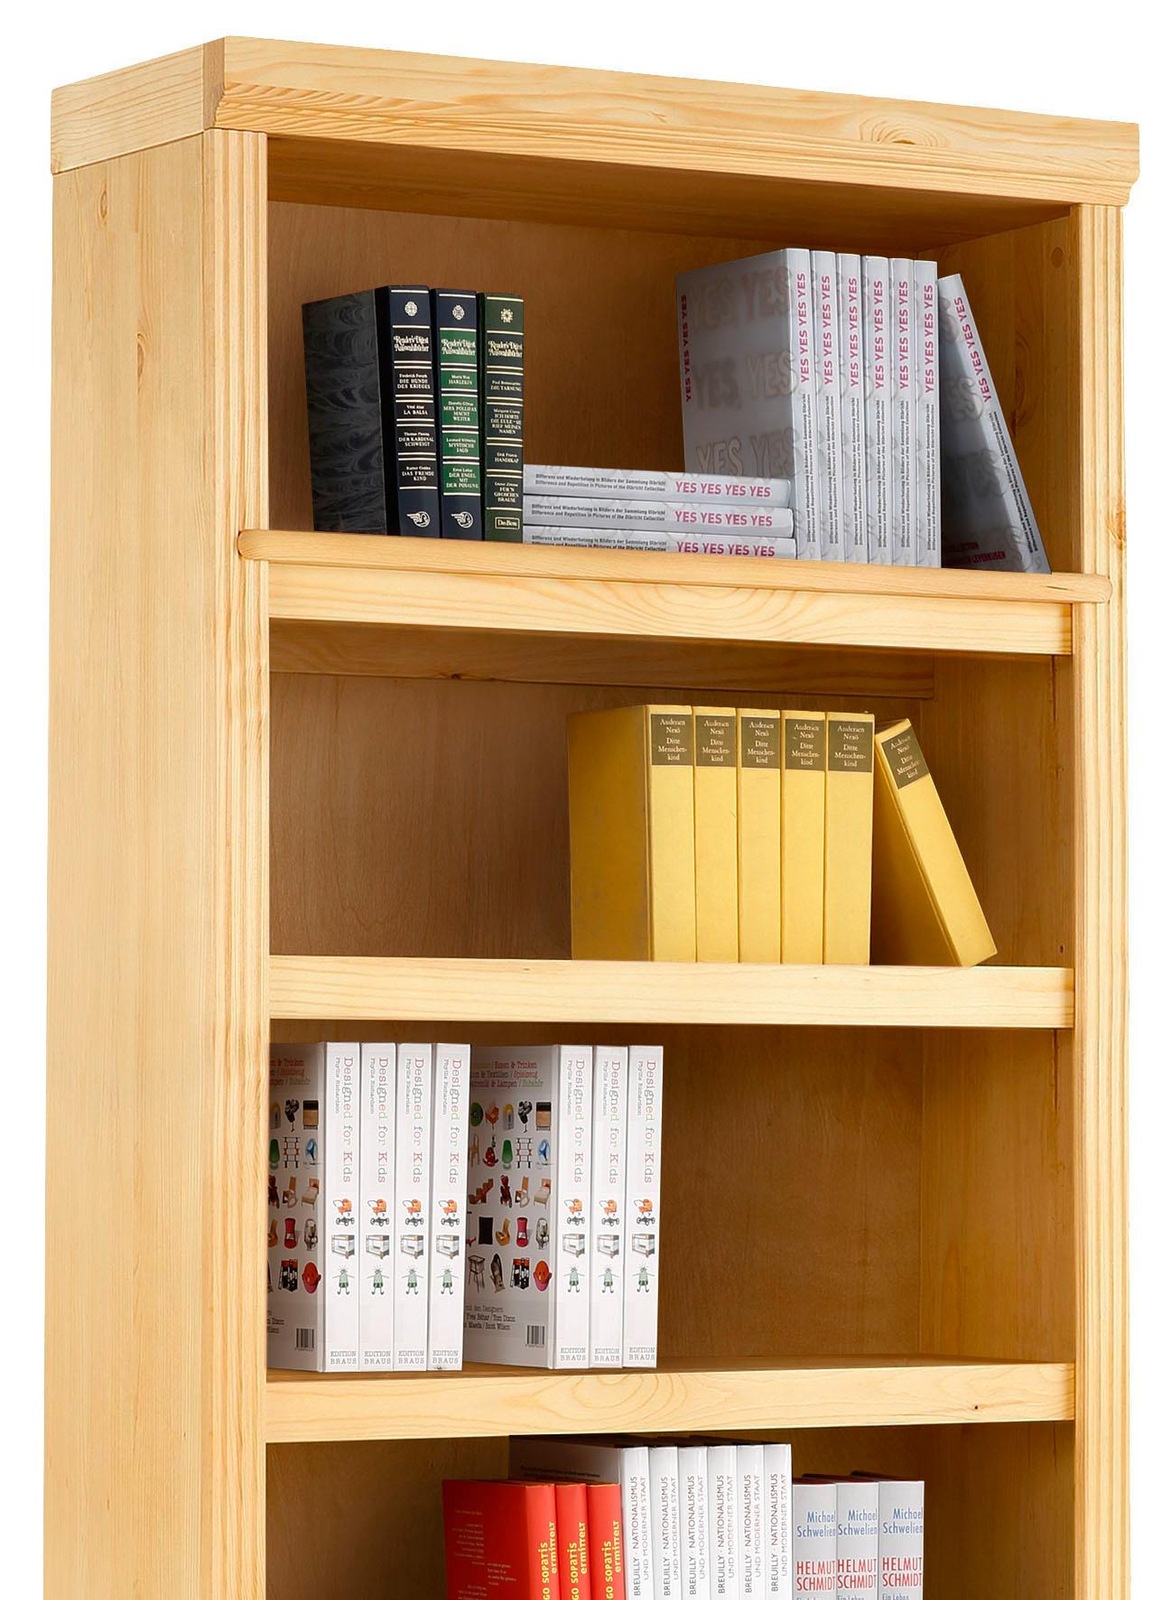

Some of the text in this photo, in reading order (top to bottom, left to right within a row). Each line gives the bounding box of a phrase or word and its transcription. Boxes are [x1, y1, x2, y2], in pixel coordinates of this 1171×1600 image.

[874, 280, 884, 389] YES YES YES YES
[954, 297, 992, 402] YES YES YES YES
[676, 481, 771, 497] YES YES YES YES
[675, 511, 772, 527] YES YES YES YES
[342, 1057, 353, 1182] Designed for Kids
[645, 1061, 656, 1183] Designed for Kids
[630, 1476, 639, 1549] NATIONALISMUS
[807, 1510, 835, 1523] Michael
[893, 1507, 922, 1519] Michael
[797, 1561, 835, 1575] HELMUT
[883, 1557, 922, 1570] HELMUT
[797, 1577, 835, 1591] SCHMIDT
[883, 1573, 922, 1587] SCHMIDT
[882, 1593, 909, 1600] Ein Leben
